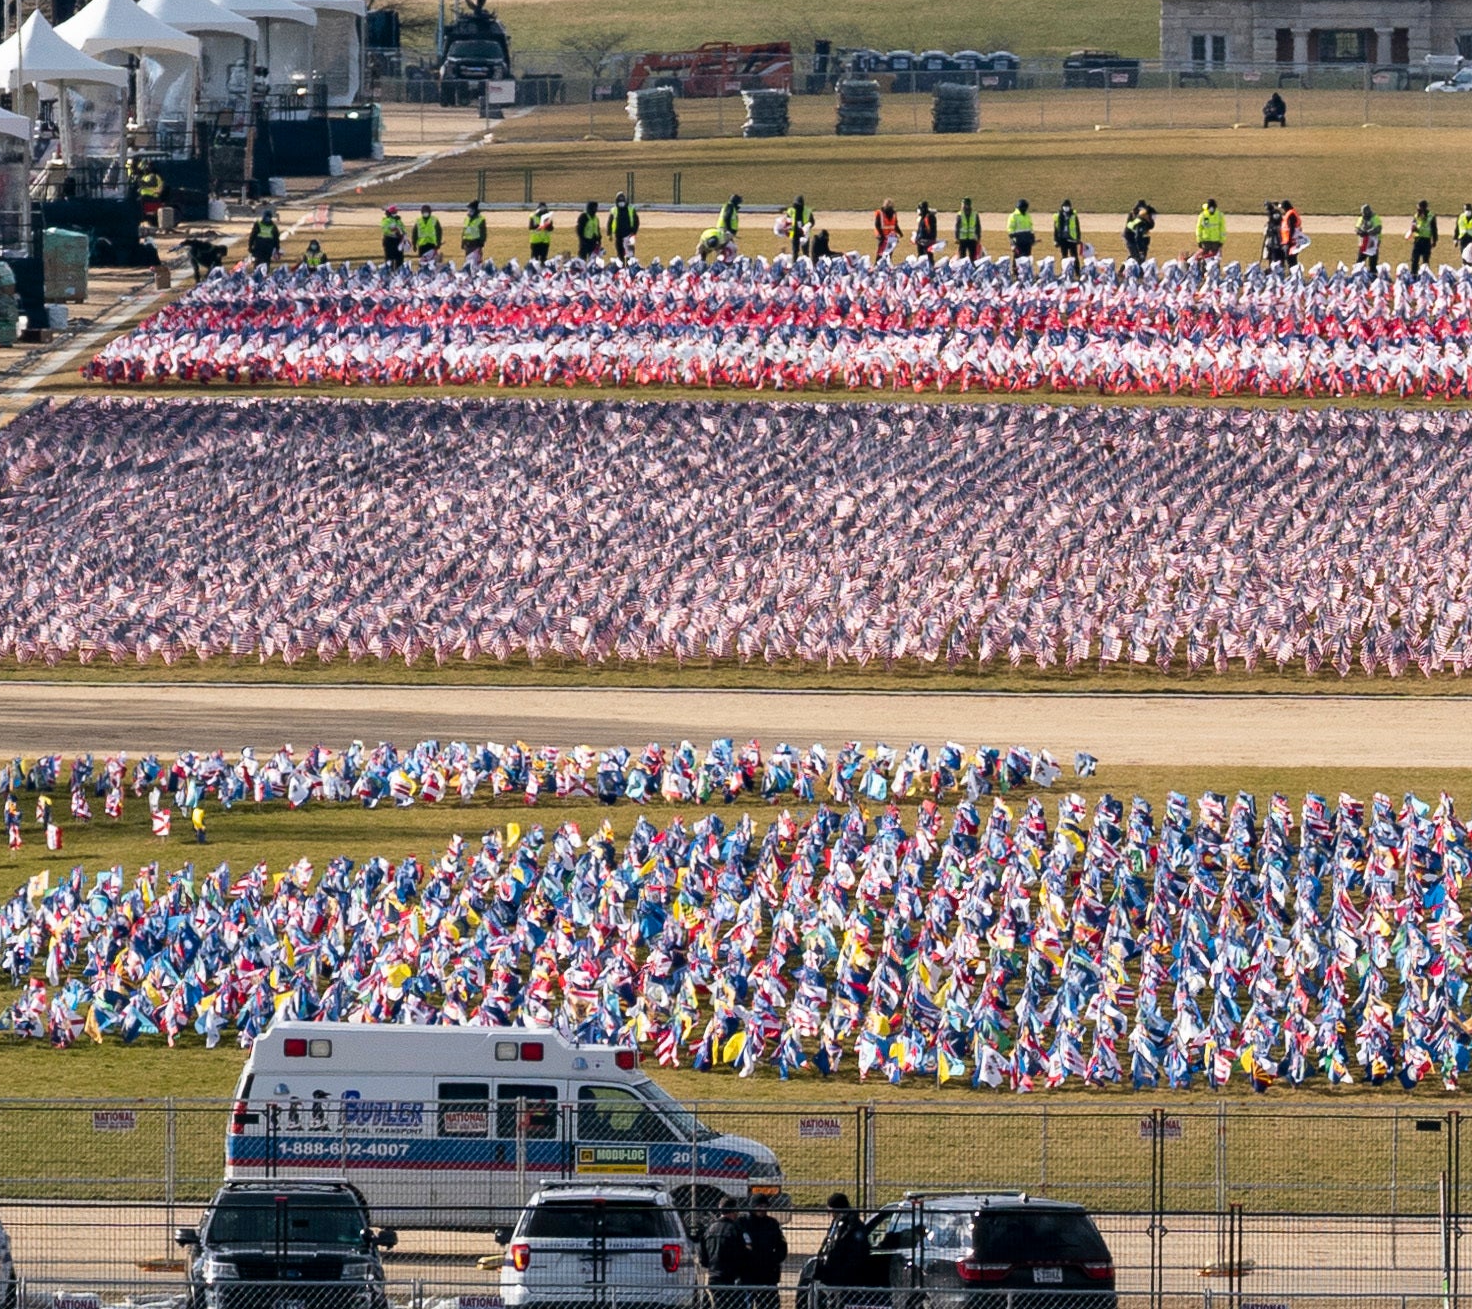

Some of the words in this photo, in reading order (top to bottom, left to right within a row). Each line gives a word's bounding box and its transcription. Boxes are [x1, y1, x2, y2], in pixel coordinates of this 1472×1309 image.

[94, 1112, 135, 1121] NATIONAL
[446, 1113, 485, 1122] NATIONAL
[800, 1119, 840, 1128] NATIONAL
[278, 1141, 410, 1156] 1-888-602-4007
[597, 1149, 645, 1161] MODU-LOC
[54, 1300, 99, 1309] NATIONAL
[459, 1298, 504, 1307] NATIONAL
